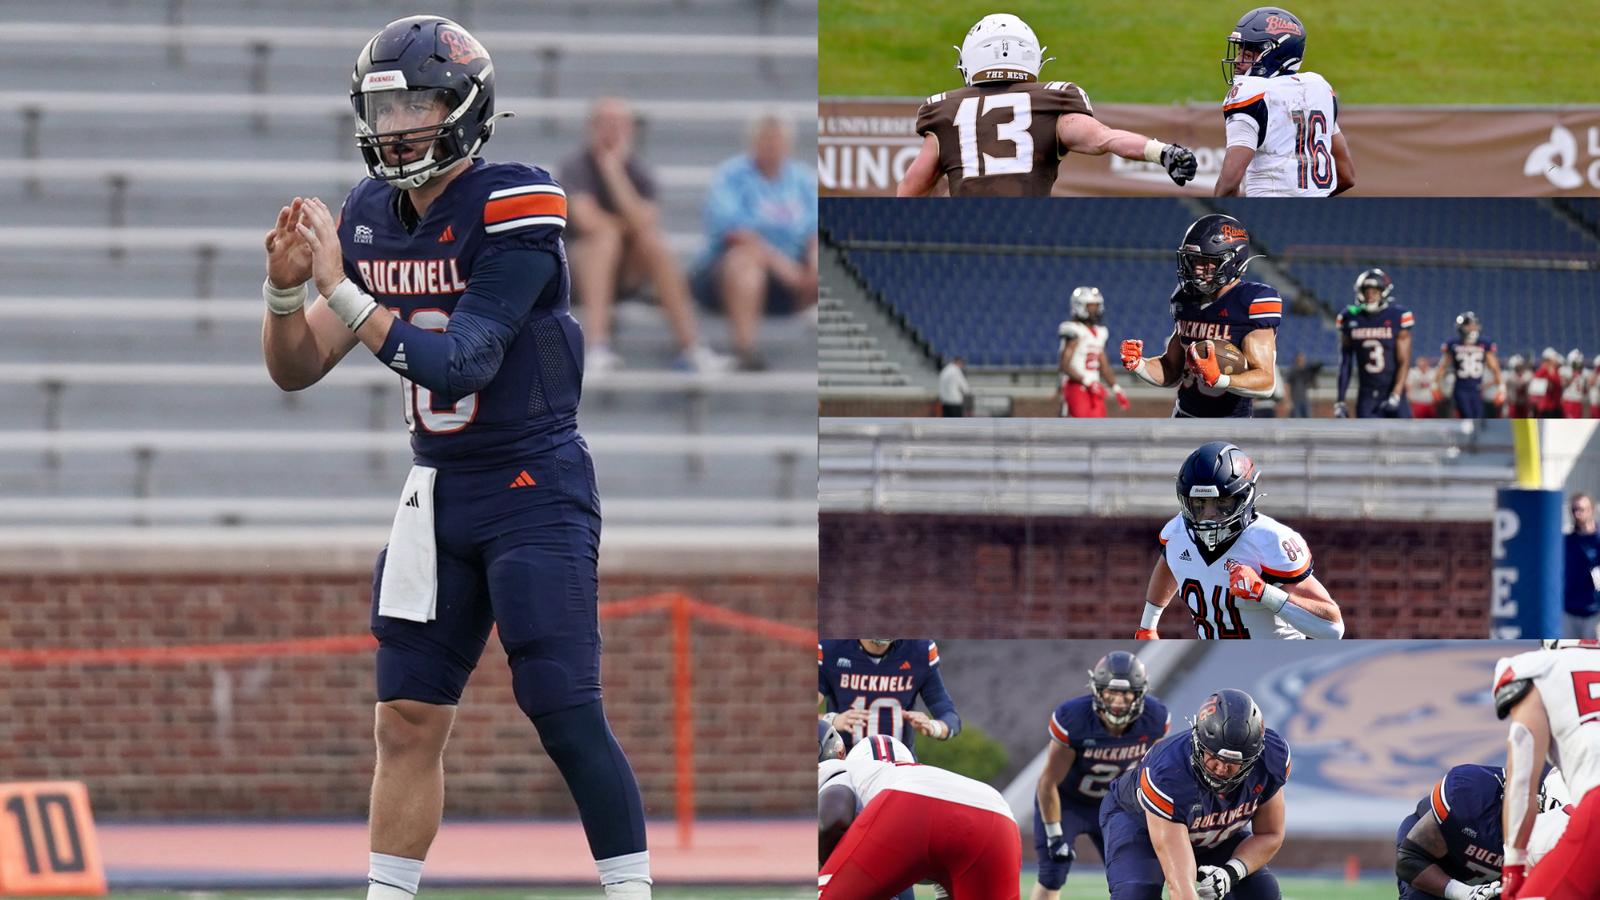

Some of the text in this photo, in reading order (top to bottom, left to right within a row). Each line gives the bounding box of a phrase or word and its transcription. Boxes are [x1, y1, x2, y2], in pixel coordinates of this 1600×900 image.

[953, 92, 1034, 179] 13
[1291, 109, 1333, 189] 16
[357, 258, 466, 295] BUCKNELL
[1362, 339, 1385, 373] 3
[1282, 538, 1304, 562] 84
[1179, 578, 1250, 639] 84
[840, 673, 913, 693] BUCKNELL
[850, 696, 903, 745] 10
[1083, 743, 1147, 760] BUCKNELL
[1191, 799, 1259, 830] BUCKNELL
[6, 793, 86, 875] 10
